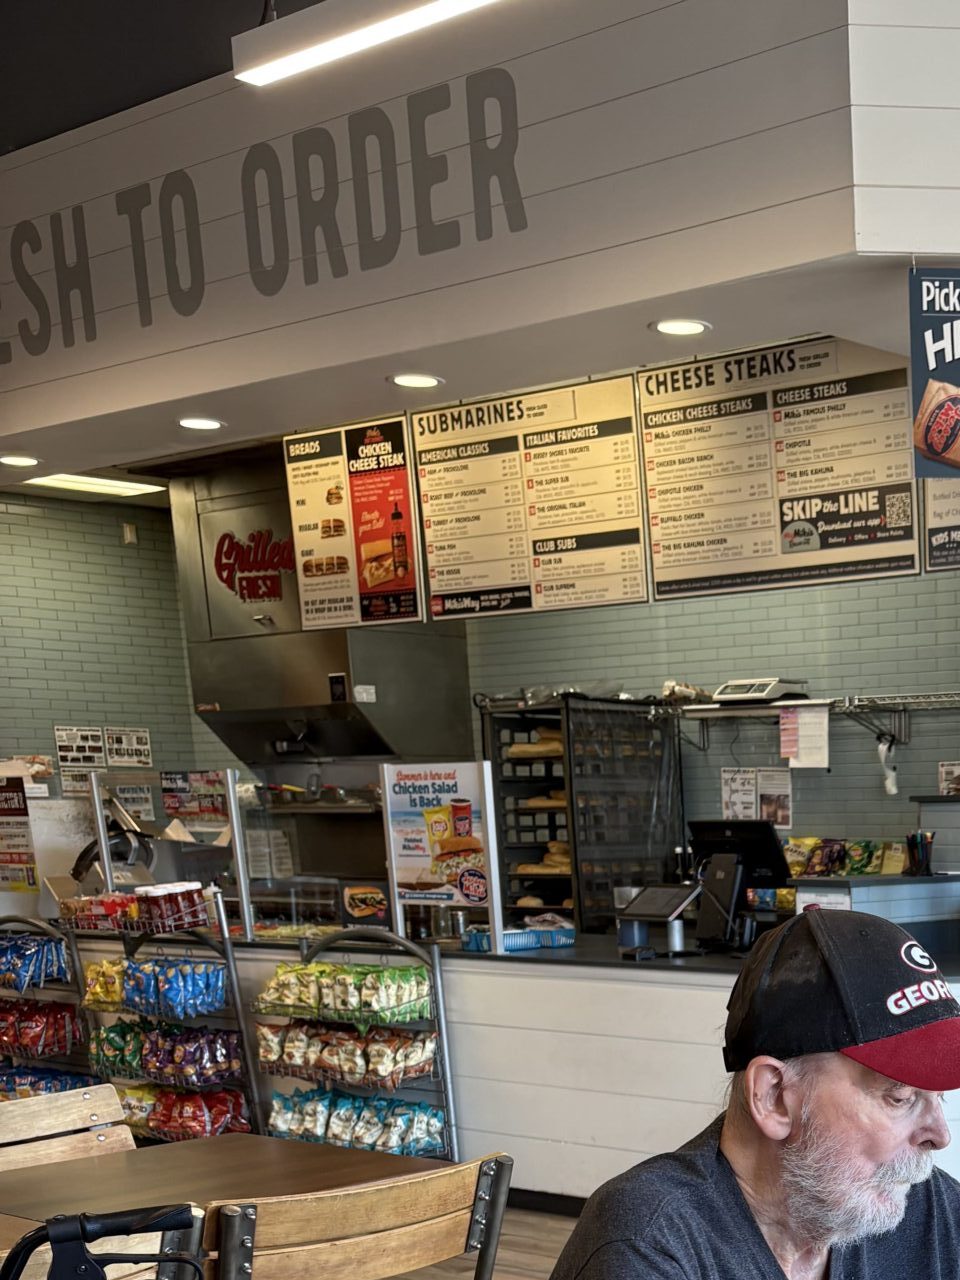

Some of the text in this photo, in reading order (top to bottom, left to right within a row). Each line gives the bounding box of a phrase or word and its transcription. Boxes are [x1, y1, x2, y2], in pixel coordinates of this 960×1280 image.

[0, 66, 528, 364] SH TO ORDER
[921, 280, 960, 311] Pick
[645, 349, 797, 396] CHEESE STEAKS
[776, 382, 848, 404] CHEESE STEAKS
[417, 400, 524, 437] SUBMARINES
[647, 398, 753, 426] CHICKEN CHEESE STEAKS
[526, 424, 600, 447] ITALIAN FAVORITES
[289, 441, 321, 457] BREADS
[358, 441, 393, 457] CHICKEN
[420, 443, 490, 464] AMERICAN CLASSICS
[349, 452, 405, 472] CHEESE STEAK
[781, 490, 880, 522] SKIP the LINE
[536, 538, 577, 553] CLUB SUBS
[392, 781, 458, 795] Chicken Salad
[410, 795, 442, 808] is Back
[886, 980, 952, 1015] GEOR
